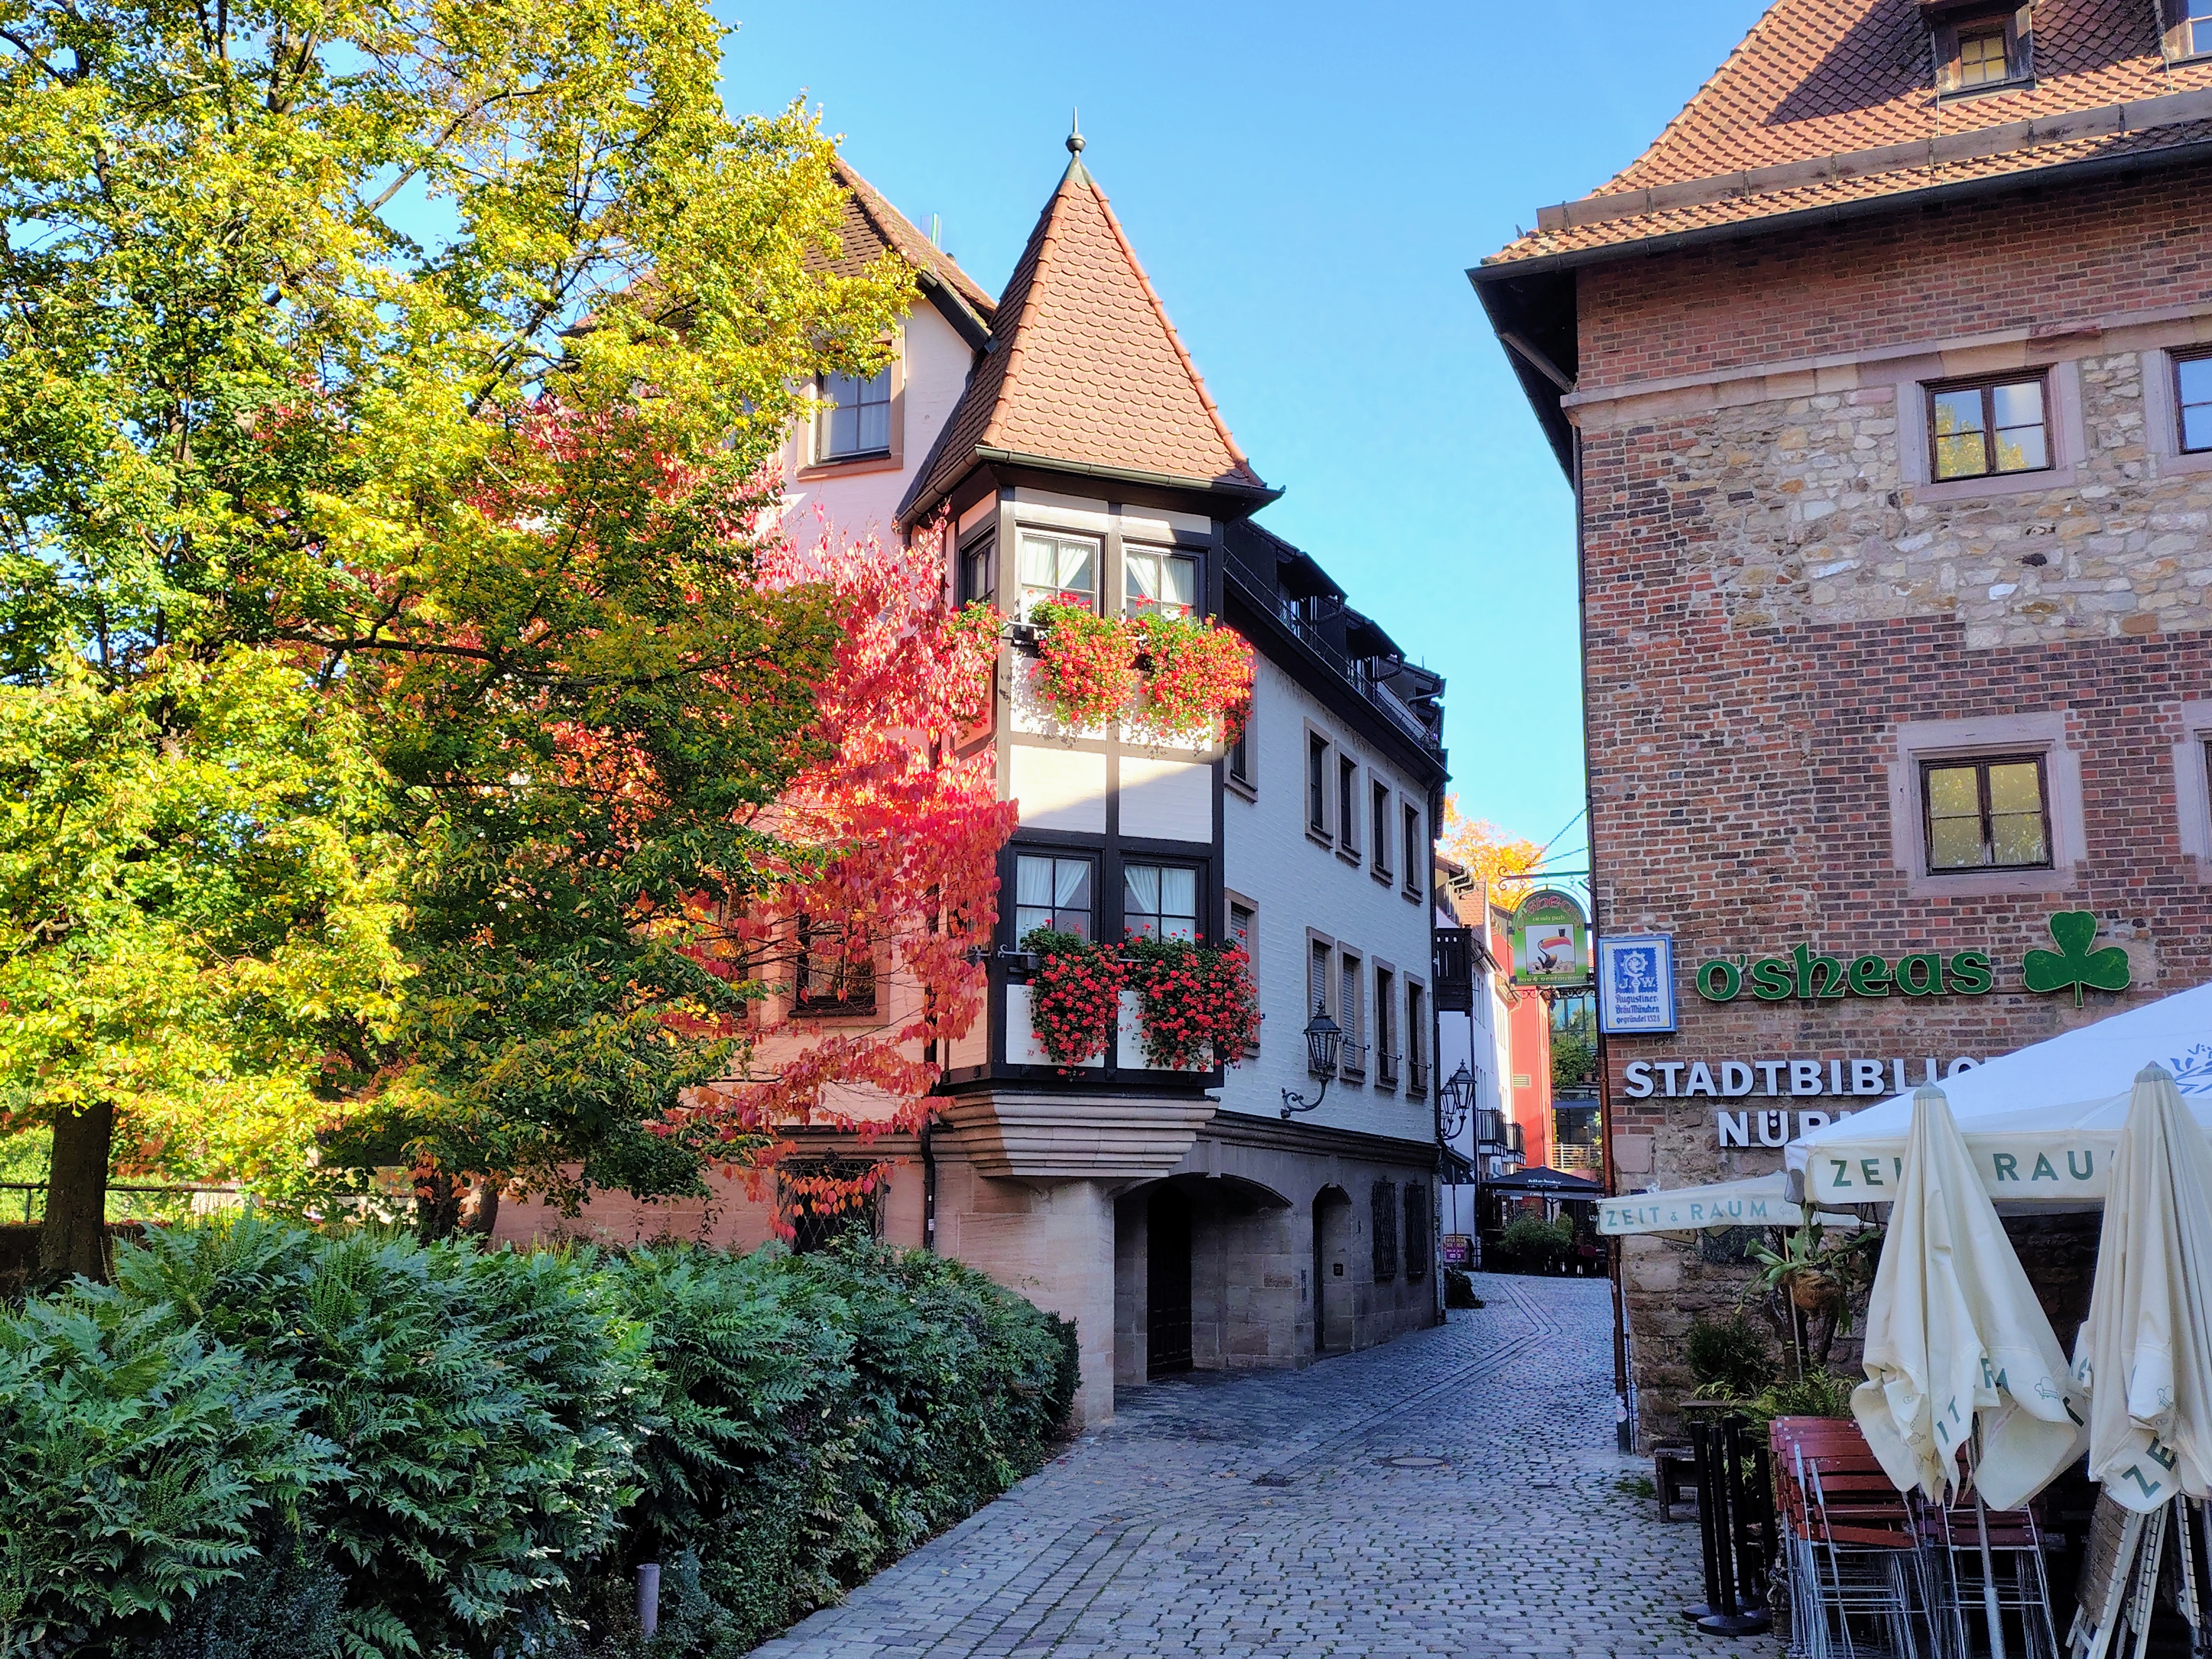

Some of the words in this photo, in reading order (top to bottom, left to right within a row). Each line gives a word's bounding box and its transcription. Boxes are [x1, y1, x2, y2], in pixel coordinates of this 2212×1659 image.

[1992, 1149, 2114, 1182] RAU
[1606, 1206, 1660, 1228] ZEIT
[1670, 1211, 1678, 1222] &
[1690, 1199, 1768, 1221] RAUM
